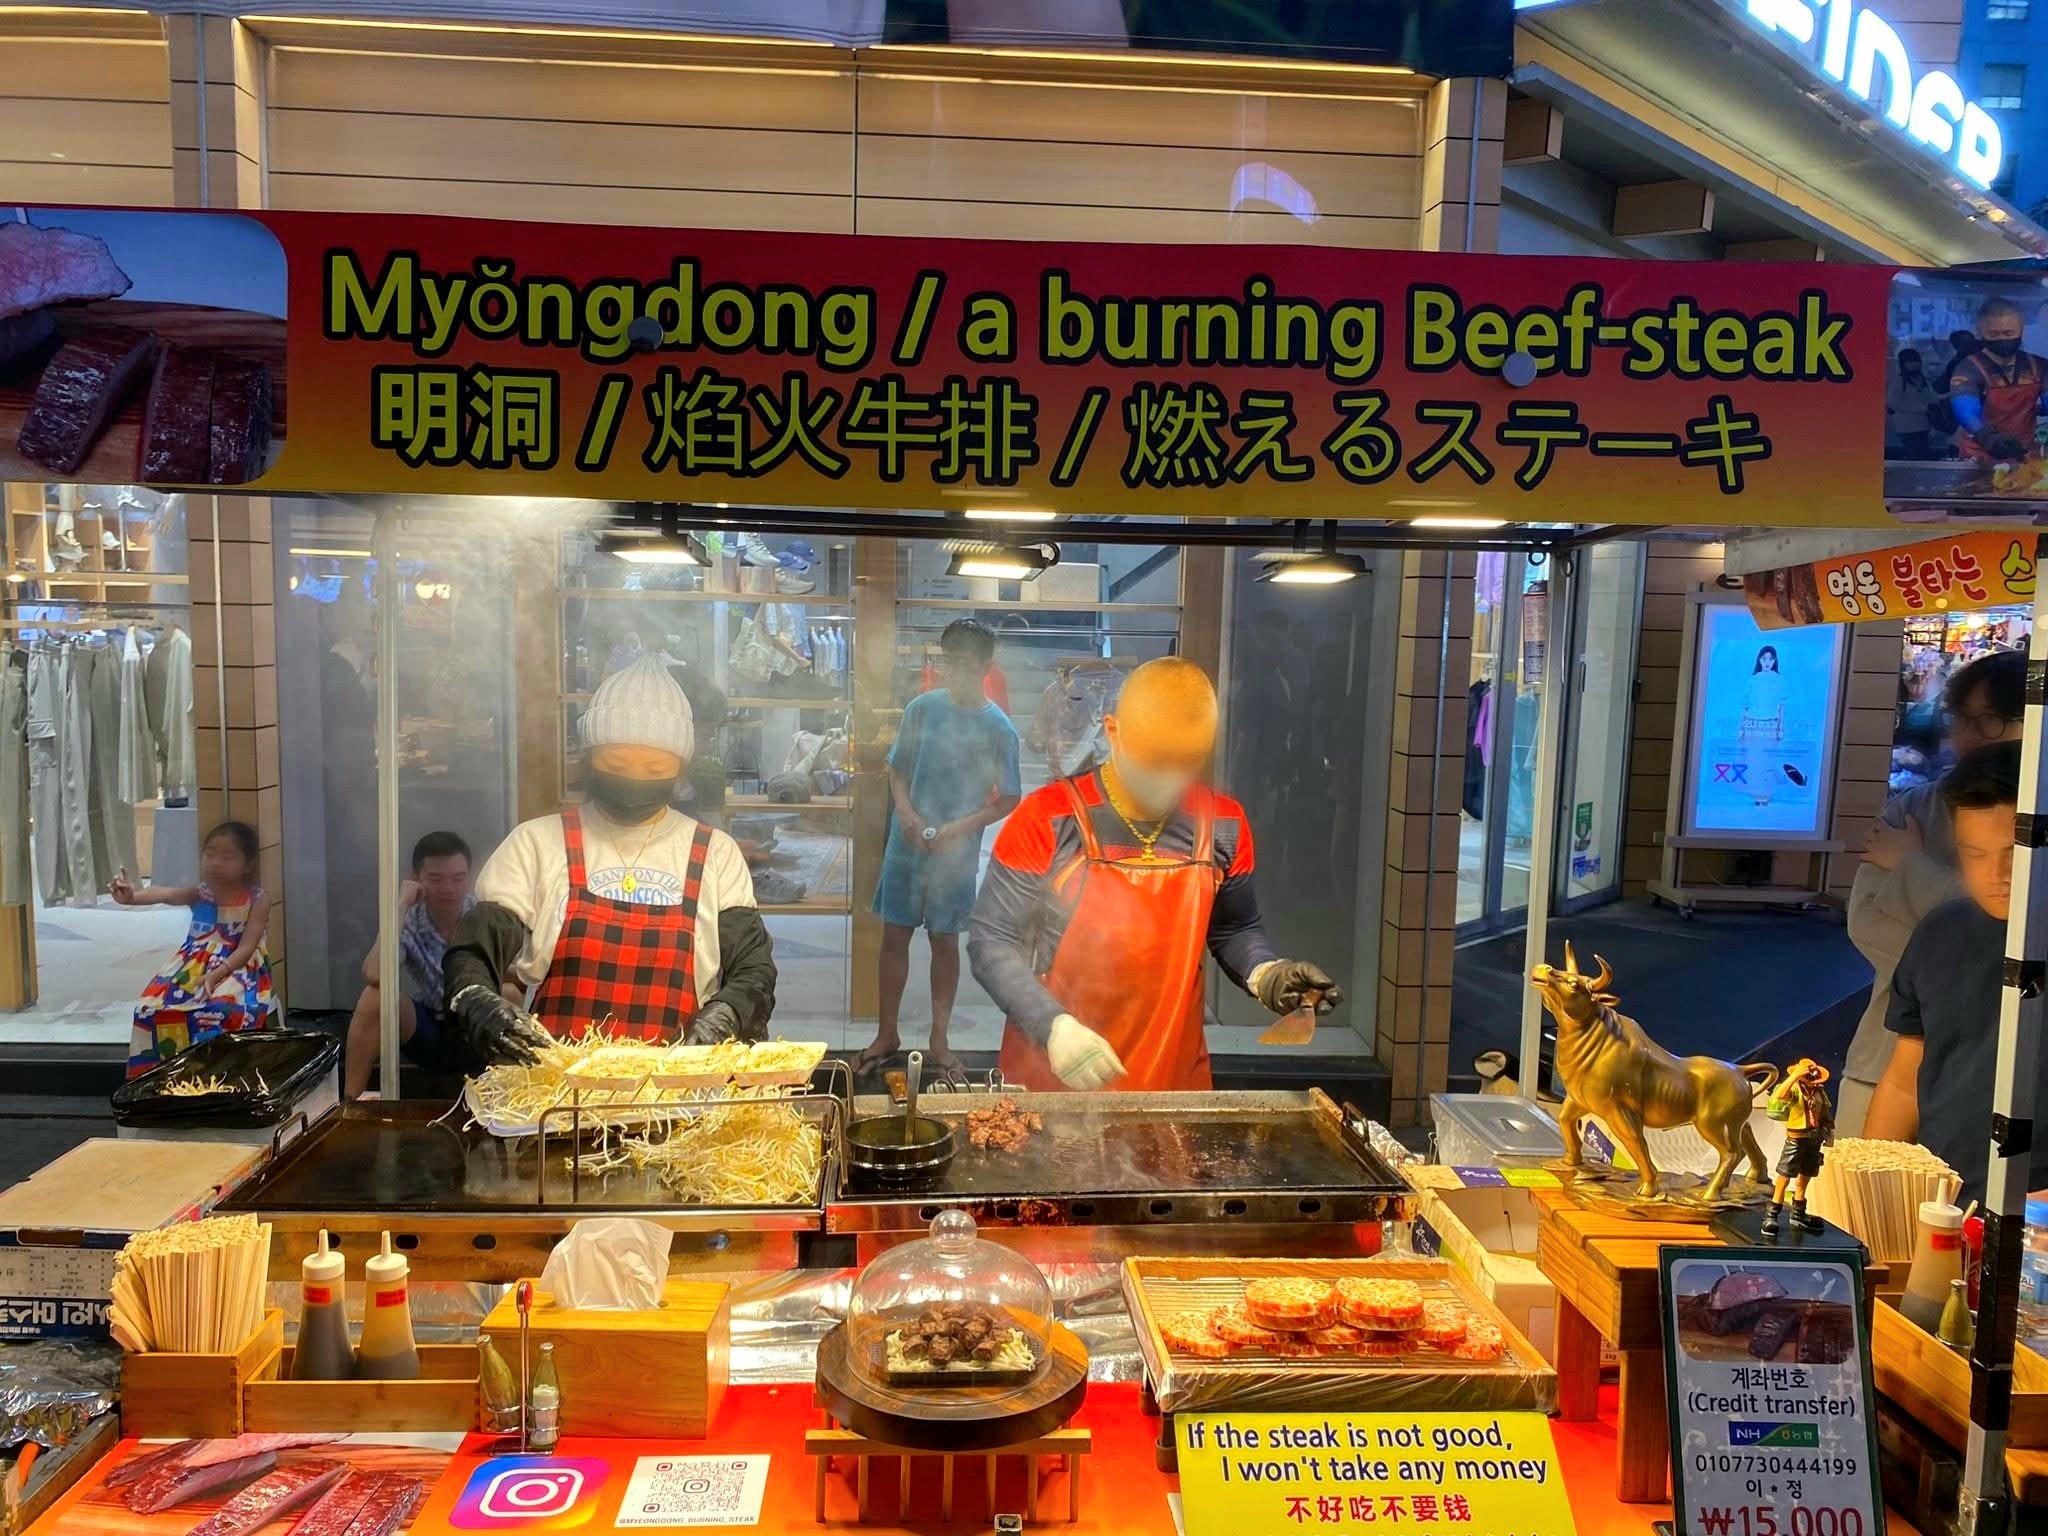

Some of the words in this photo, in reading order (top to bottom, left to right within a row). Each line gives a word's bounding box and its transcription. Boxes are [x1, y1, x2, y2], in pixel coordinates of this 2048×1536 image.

[329, 253, 870, 367] Myŏngdong
[965, 298, 1010, 356] a
[1046, 275, 1377, 379] burning
[1412, 289, 1846, 376] Beef-steak
[379, 370, 558, 463] 明洞
[650, 371, 1033, 479] 焰火牛排
[1127, 388, 1771, 487] 燃えるステーキ
[1731, 1367, 1809, 1392] 계좌번호
[1687, 1391, 1759, 1415] (Credit
[1764, 1395, 1856, 1418] transfer)
[1187, 1423, 1205, 1449] If
[1214, 1424, 1260, 1449] the
[1268, 1424, 1340, 1449] steak
[1347, 1422, 1369, 1448] is
[1376, 1425, 1425, 1448] not
[1432, 1421, 1513, 1452] good,
[1735, 1428, 1761, 1440] NH
[1221, 1456, 1230, 1482] I
[1238, 1456, 1324, 1482] won't
[1330, 1454, 1389, 1482] take
[1398, 1458, 1445, 1485] any
[1455, 1457, 1548, 1485] money
[1695, 1454, 1857, 1476] 0107730444199
[1285, 1494, 1472, 1524] 不好吃不要钱
